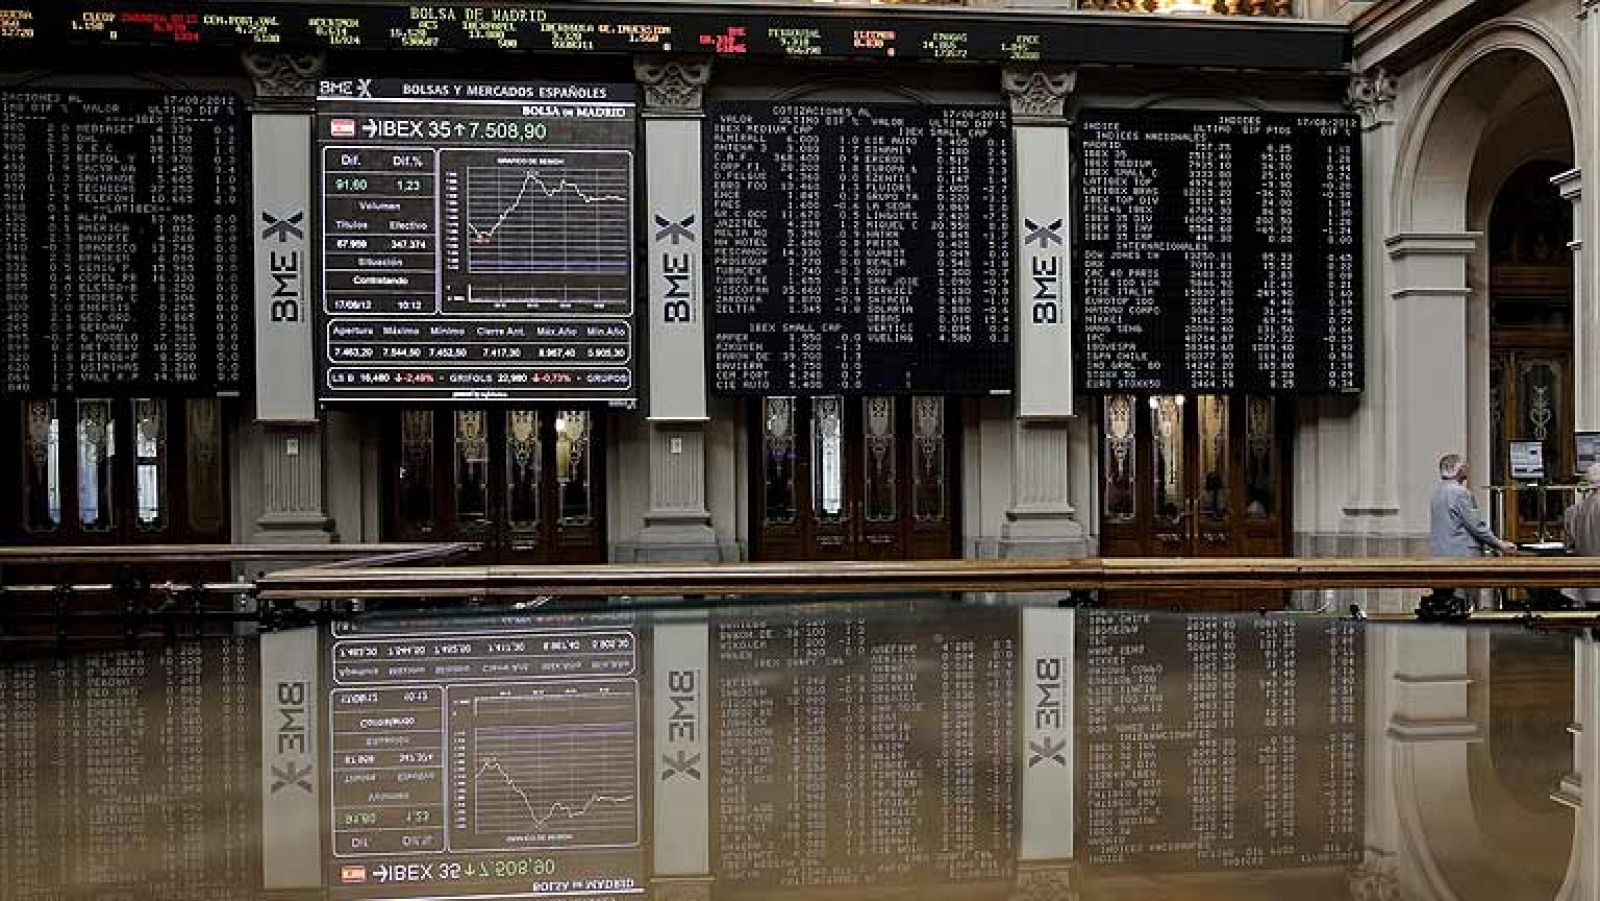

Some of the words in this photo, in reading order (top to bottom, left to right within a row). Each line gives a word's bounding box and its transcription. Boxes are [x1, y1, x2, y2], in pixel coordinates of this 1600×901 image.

[410, 6, 456, 20] BOLSA
[465, 7, 484, 21] DE
[493, 9, 547, 22] MADRID
[403, 83, 449, 95] BOLSAS
[454, 85, 463, 95] Y
[466, 85, 533, 97] MERCADOS
[539, 86, 607, 98] ESPAÑOLES
[199, 106, 219, 115] DIF
[522, 106, 561, 115] BOLSA
[576, 107, 626, 117] MADRID
[773, 106, 852, 117] COTIZACIONES
[379, 120, 423, 137] IBEX
[429, 121, 451, 138] 35
[469, 122, 547, 142] 7.508,90
[746, 125, 787, 134] MEDIUM
[793, 125, 813, 134] CAP
[974, 120, 993, 128] DIF
[1096, 131, 1138, 140] INDICES
[1145, 133, 1207, 142] NACIONALES
[341, 153, 361, 166] Dif.
[393, 155, 423, 167] Dif.%
[271, 251, 299, 322] BME
[662, 253, 690, 323] BME
[1033, 256, 1057, 324] BME
